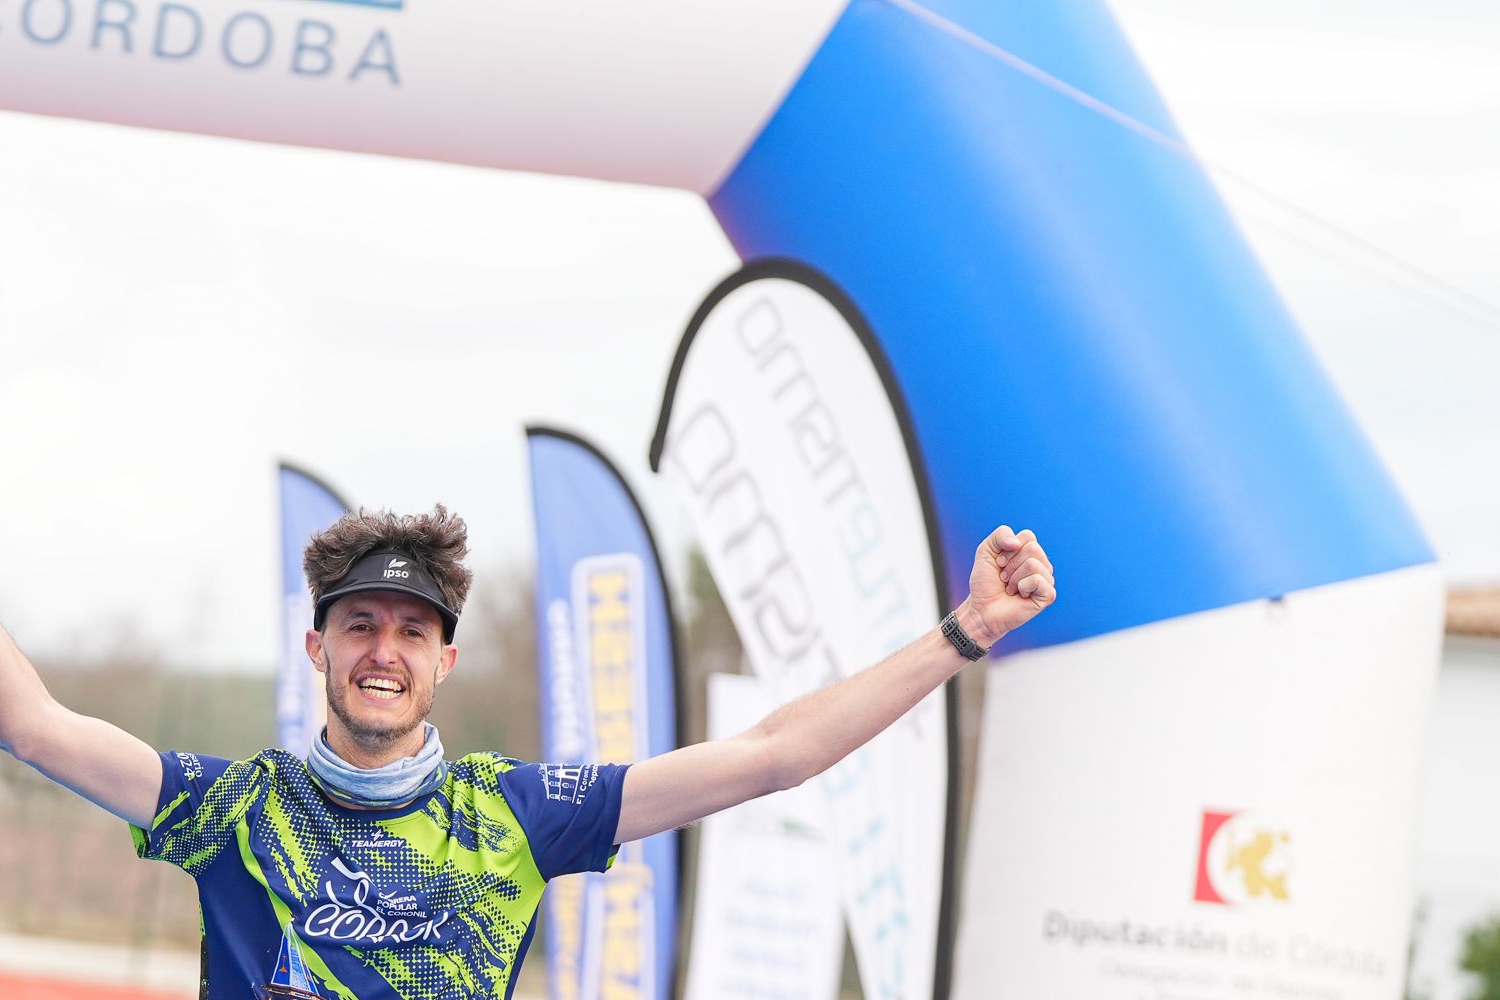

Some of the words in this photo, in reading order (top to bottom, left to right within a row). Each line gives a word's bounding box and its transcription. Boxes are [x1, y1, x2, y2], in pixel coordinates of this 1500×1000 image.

[351, 839, 404, 848] TEAMERGY
[377, 899, 418, 911] POPULAR
[387, 910, 428, 919] CORONIL
